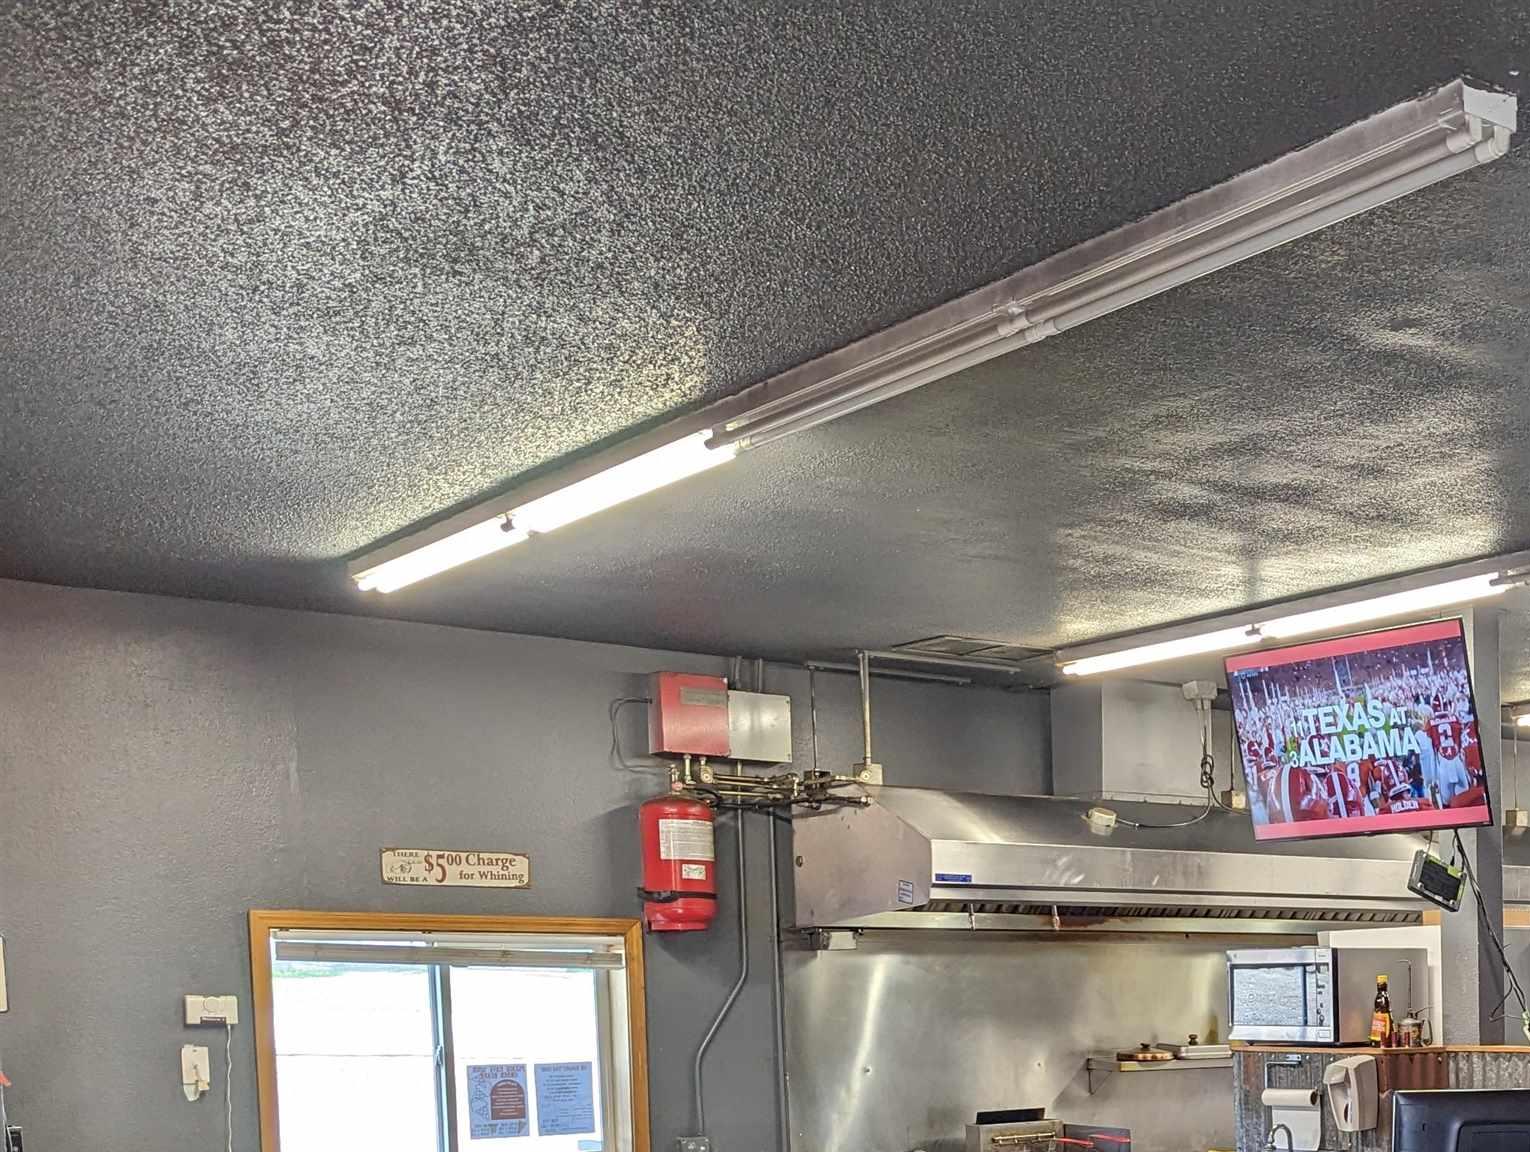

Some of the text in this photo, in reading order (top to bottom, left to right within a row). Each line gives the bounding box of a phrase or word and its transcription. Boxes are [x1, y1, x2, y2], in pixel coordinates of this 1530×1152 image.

[1304, 699, 1386, 735] TEXAS
[1389, 706, 1408, 726] AT
[1289, 726, 1422, 768] 3 ALABAMA
[465, 853, 516, 871] Charge
[458, 870, 525, 883] for Whining
